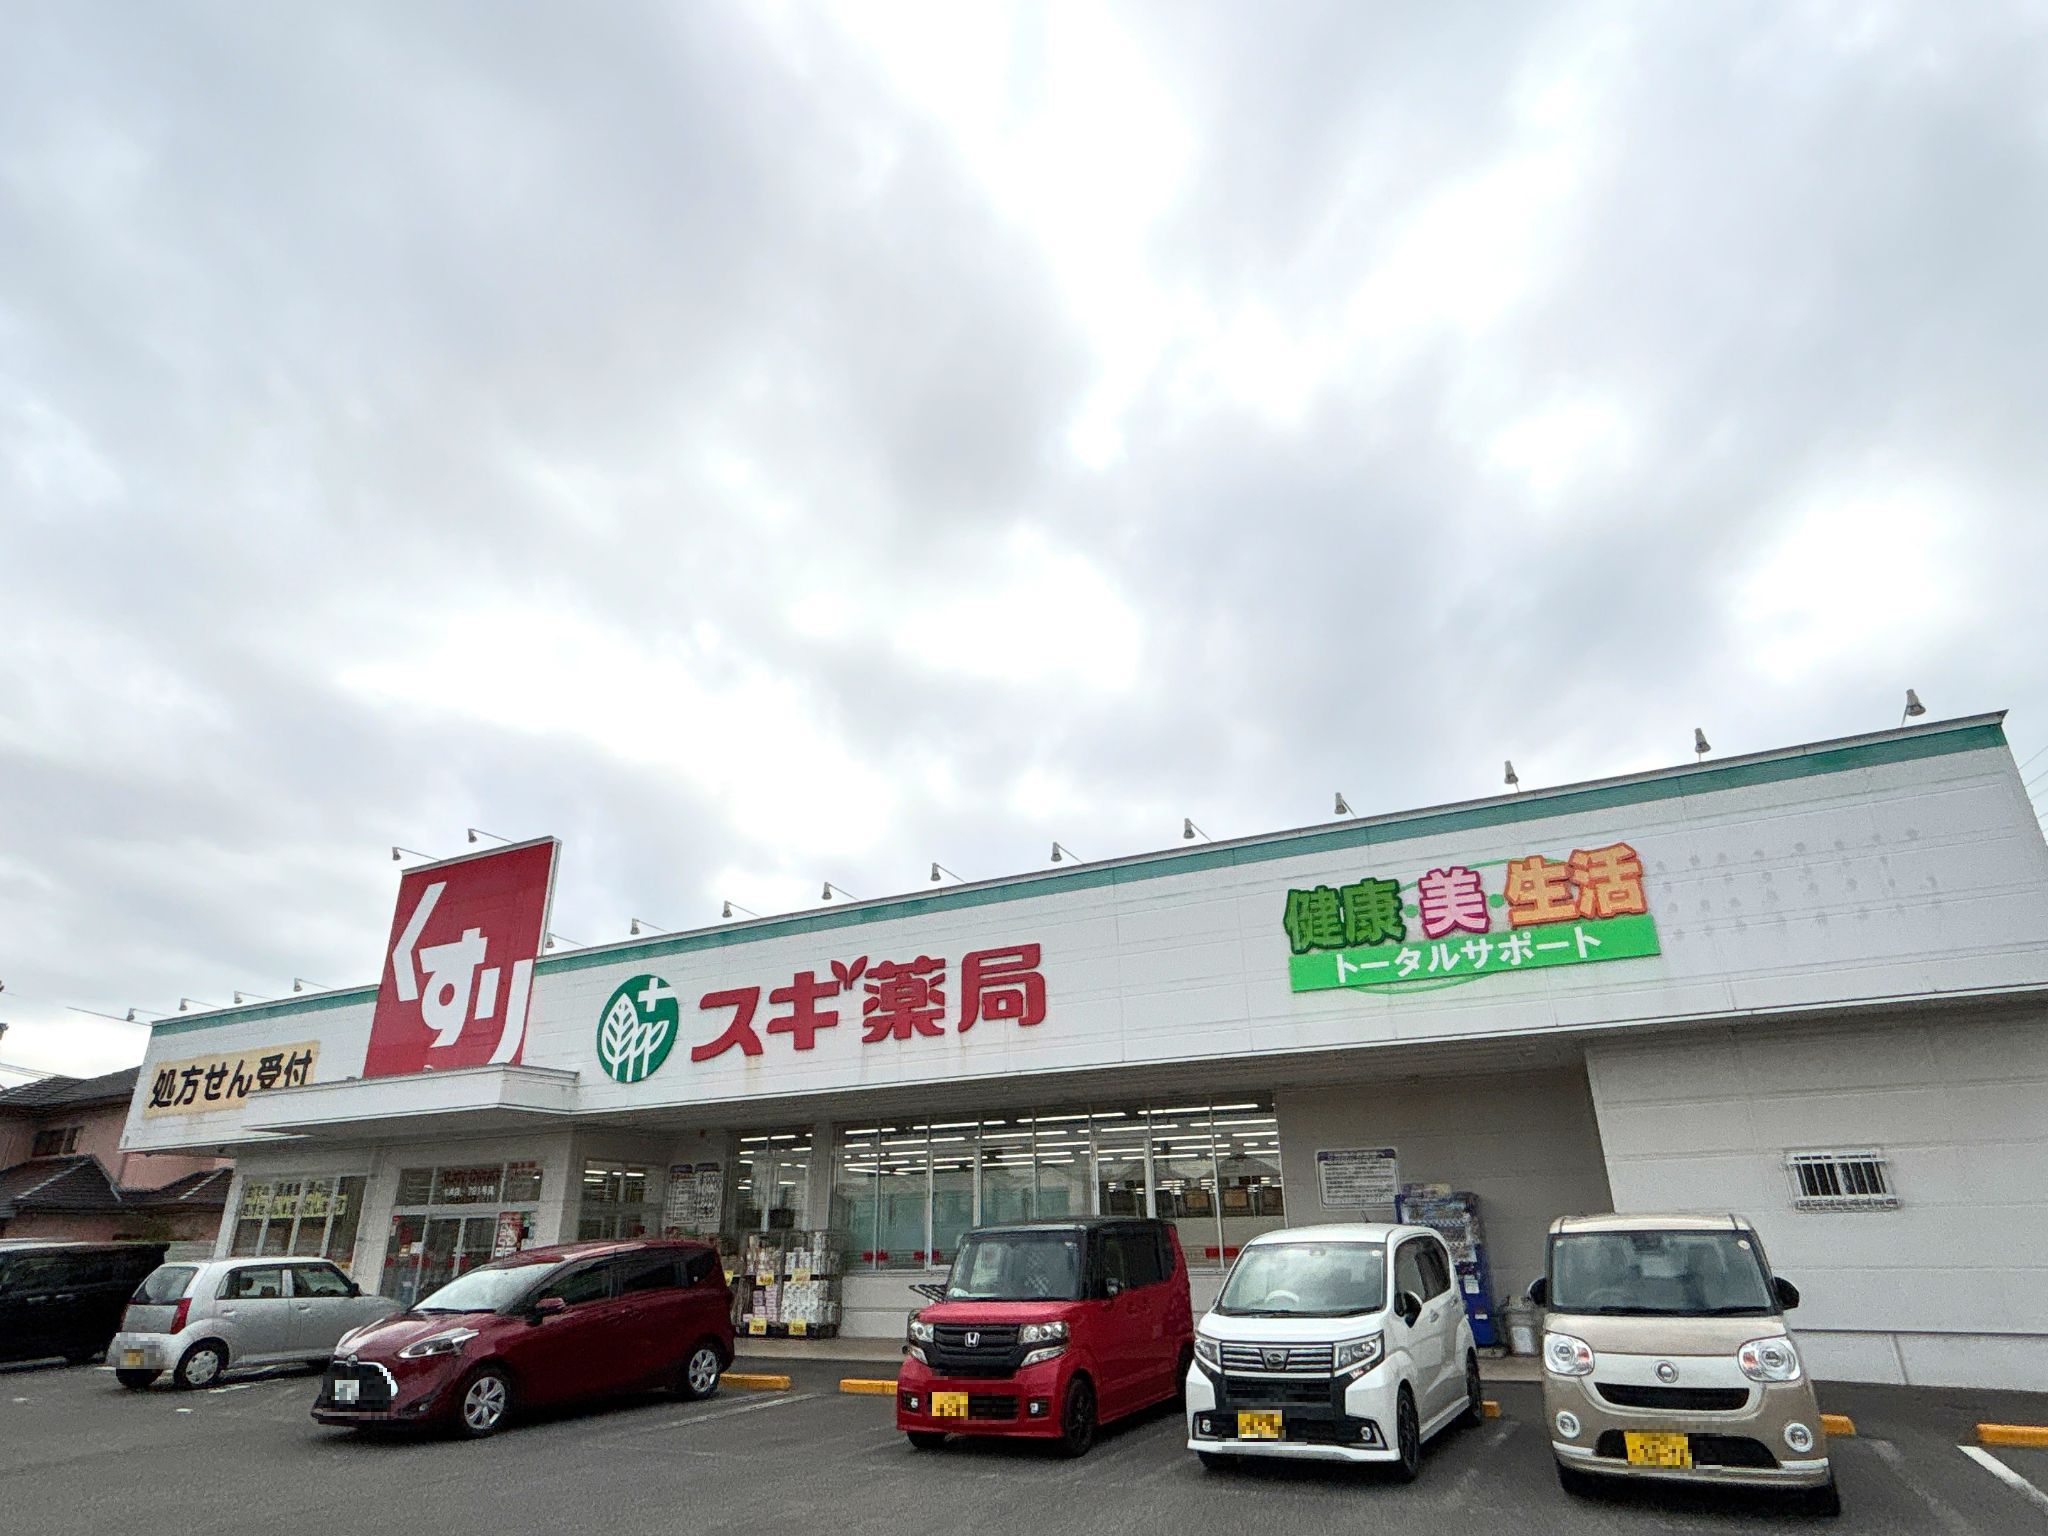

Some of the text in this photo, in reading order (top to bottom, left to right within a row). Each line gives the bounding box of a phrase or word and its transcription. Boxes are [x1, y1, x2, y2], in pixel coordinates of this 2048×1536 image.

[392, 881, 534, 1064] くすり
[1337, 926, 1601, 983] トータルサポート
[691, 943, 1046, 1062] スギ薬局
[149, 1049, 313, 1108] 処方せん受付
